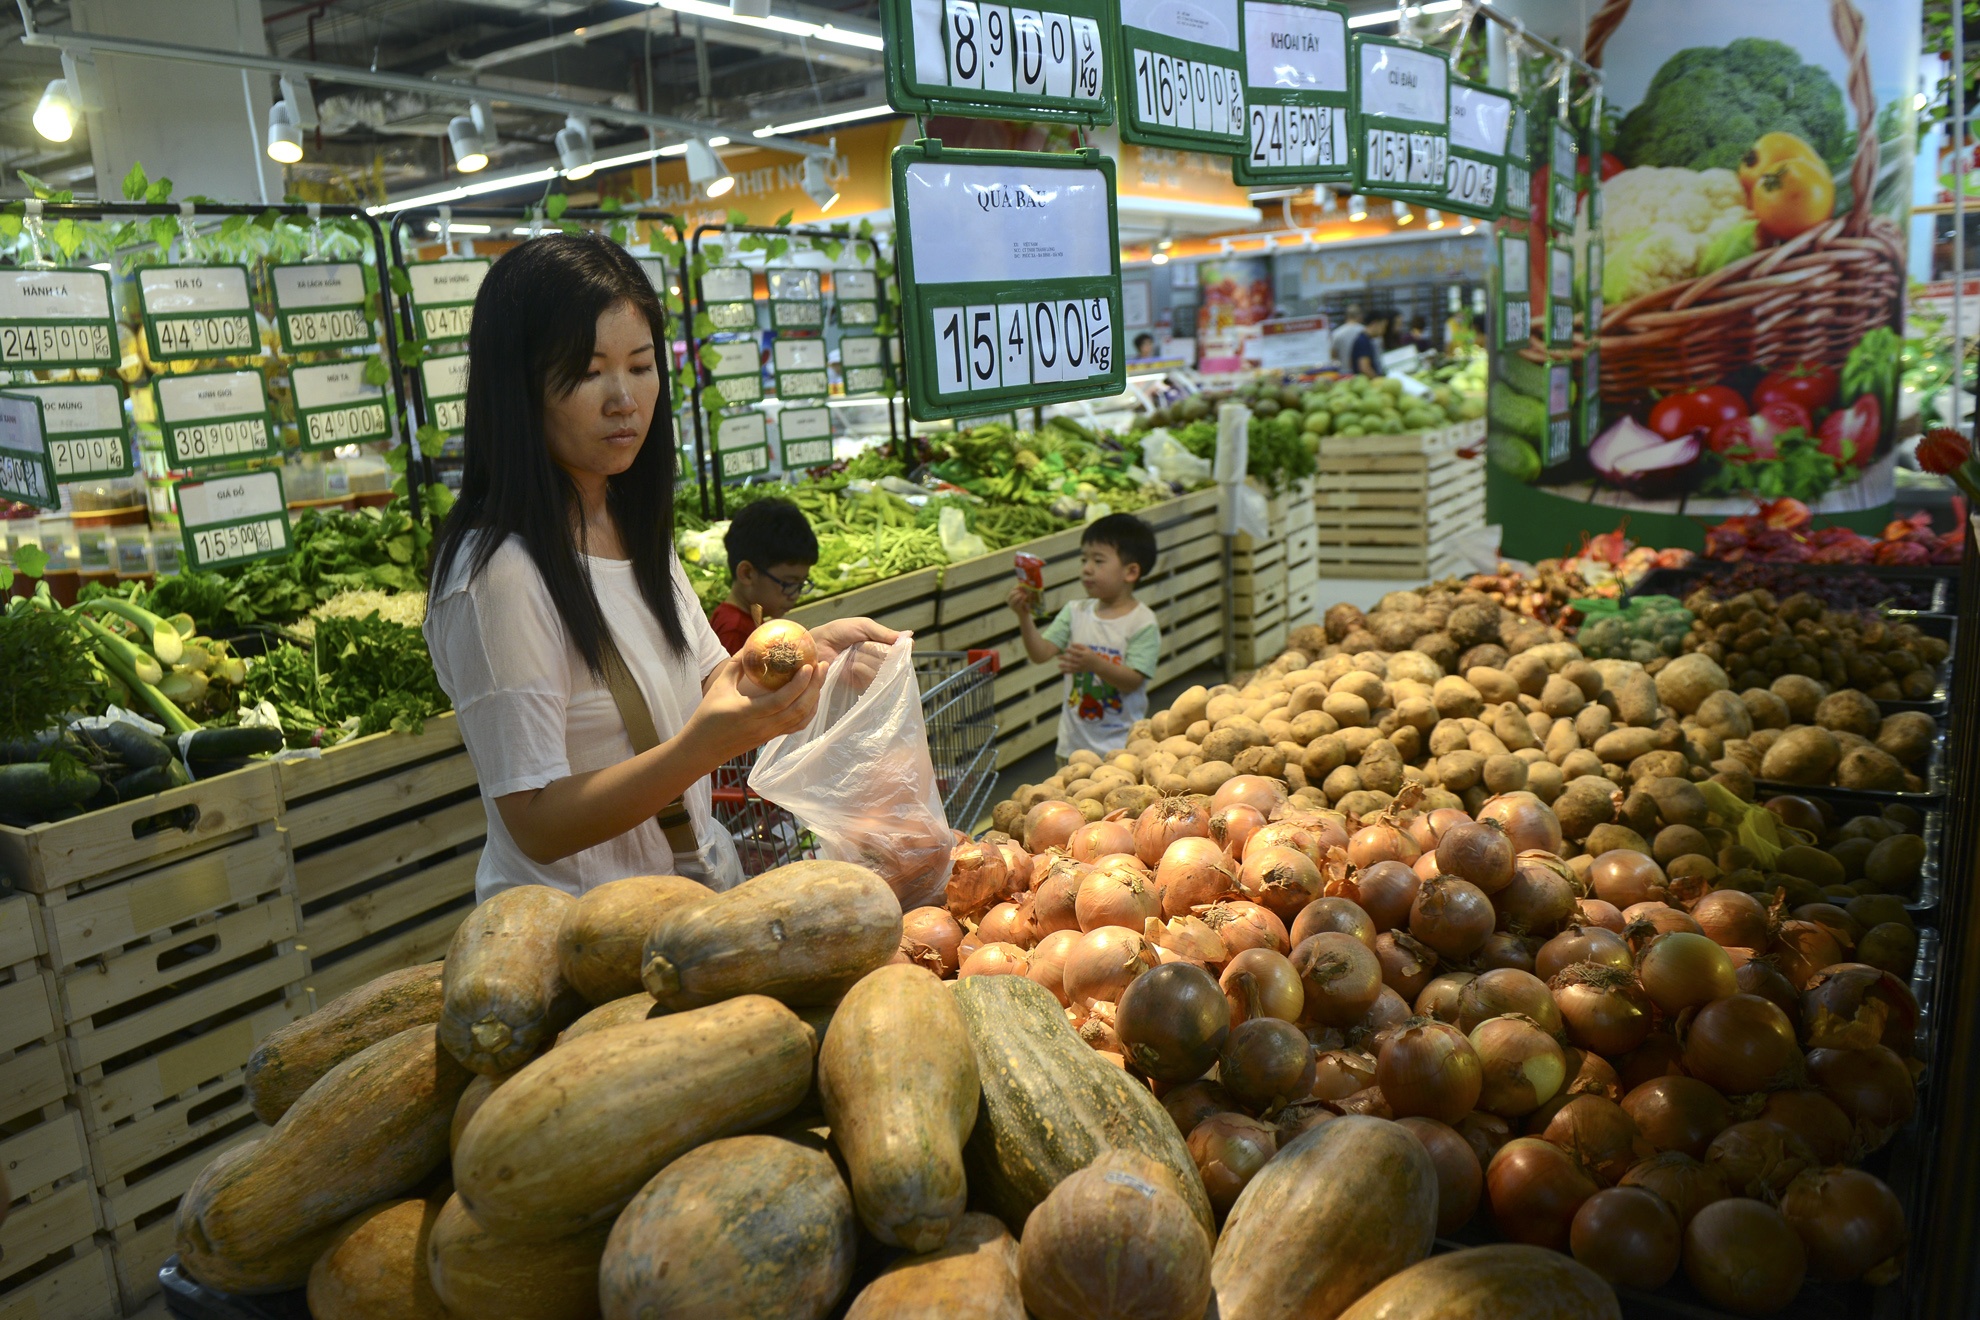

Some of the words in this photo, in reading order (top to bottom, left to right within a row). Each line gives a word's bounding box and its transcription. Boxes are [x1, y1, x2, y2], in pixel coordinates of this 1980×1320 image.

[1270, 31, 1299, 51] KHOAI
[1301, 33, 1320, 52] TÂY
[977, 184, 1012, 213] QUẢ
[174, 278, 189, 288] TÍA
[22, 284, 52, 296] HÀNH
[216, 488, 231, 500] GIÁ
